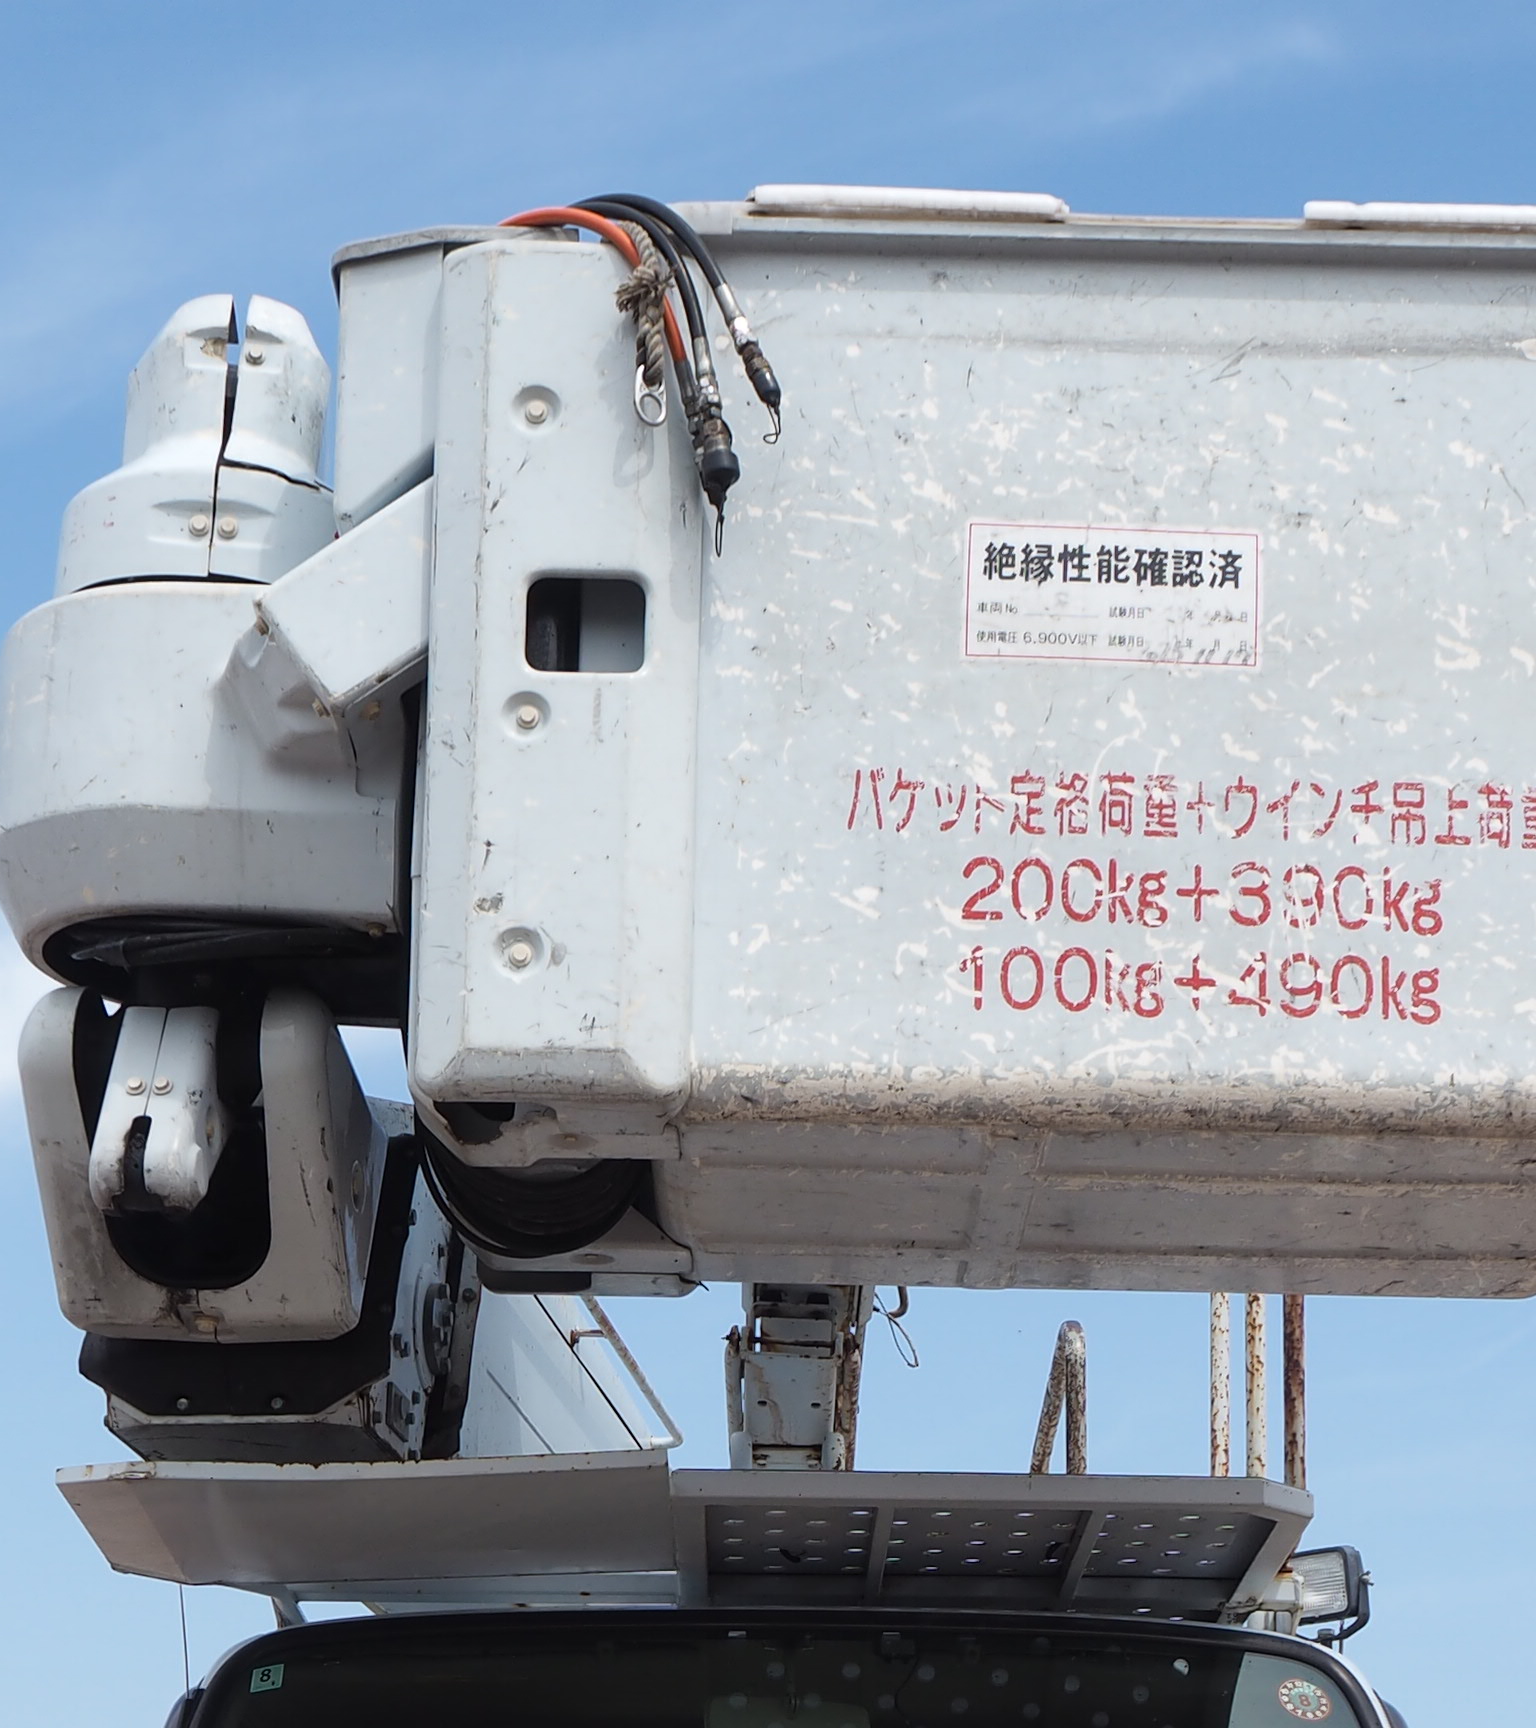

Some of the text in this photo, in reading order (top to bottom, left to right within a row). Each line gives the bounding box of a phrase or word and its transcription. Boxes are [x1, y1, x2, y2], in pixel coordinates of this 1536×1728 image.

[982, 541, 1244, 589] 絶縁性能確認済
[962, 856, 1443, 936] 200kg+390kg
[960, 946, 1442, 1025] 100kg+490kg
[259, 1668, 272, 1683] 8
